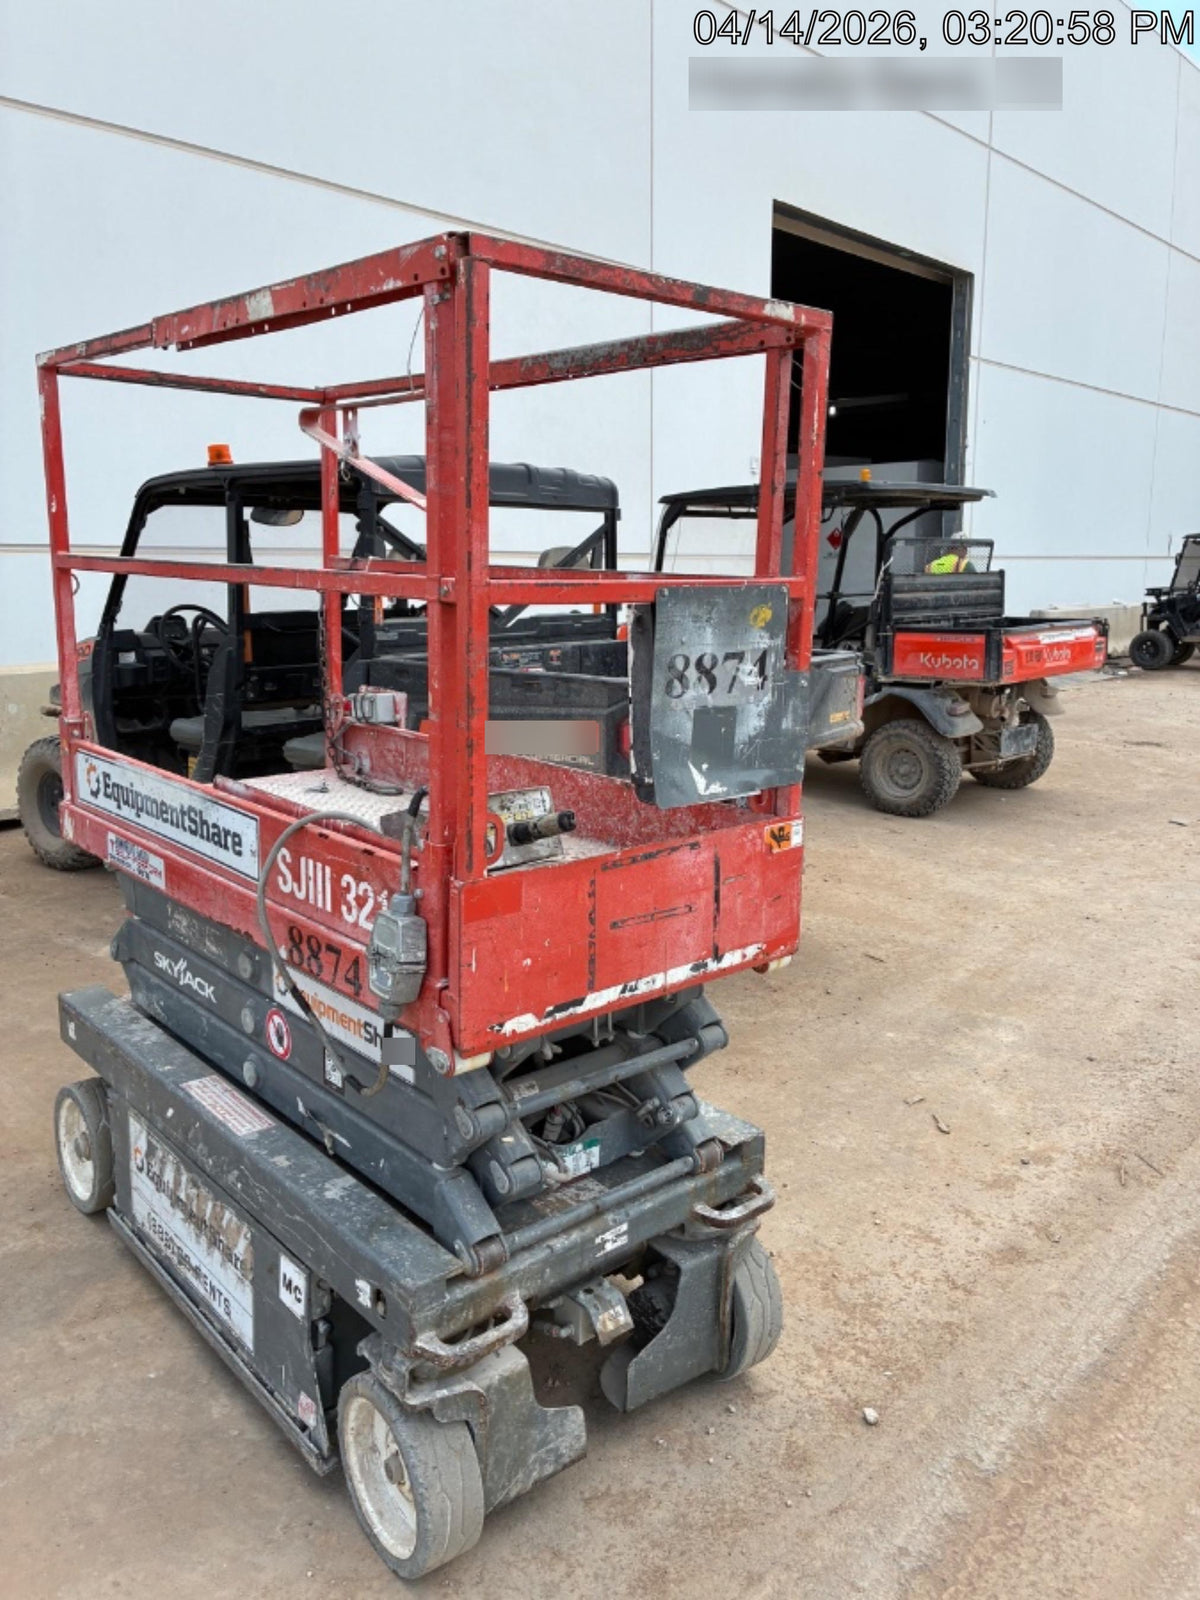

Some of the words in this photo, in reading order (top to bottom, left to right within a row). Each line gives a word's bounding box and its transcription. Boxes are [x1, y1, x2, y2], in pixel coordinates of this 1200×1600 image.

[919, 652, 980, 671] Kubota
[102, 771, 243, 857] EquipmentShare
[154, 951, 217, 1004] SKYJACK
[288, 925, 363, 996] 8874
[282, 1272, 303, 1304] MC
